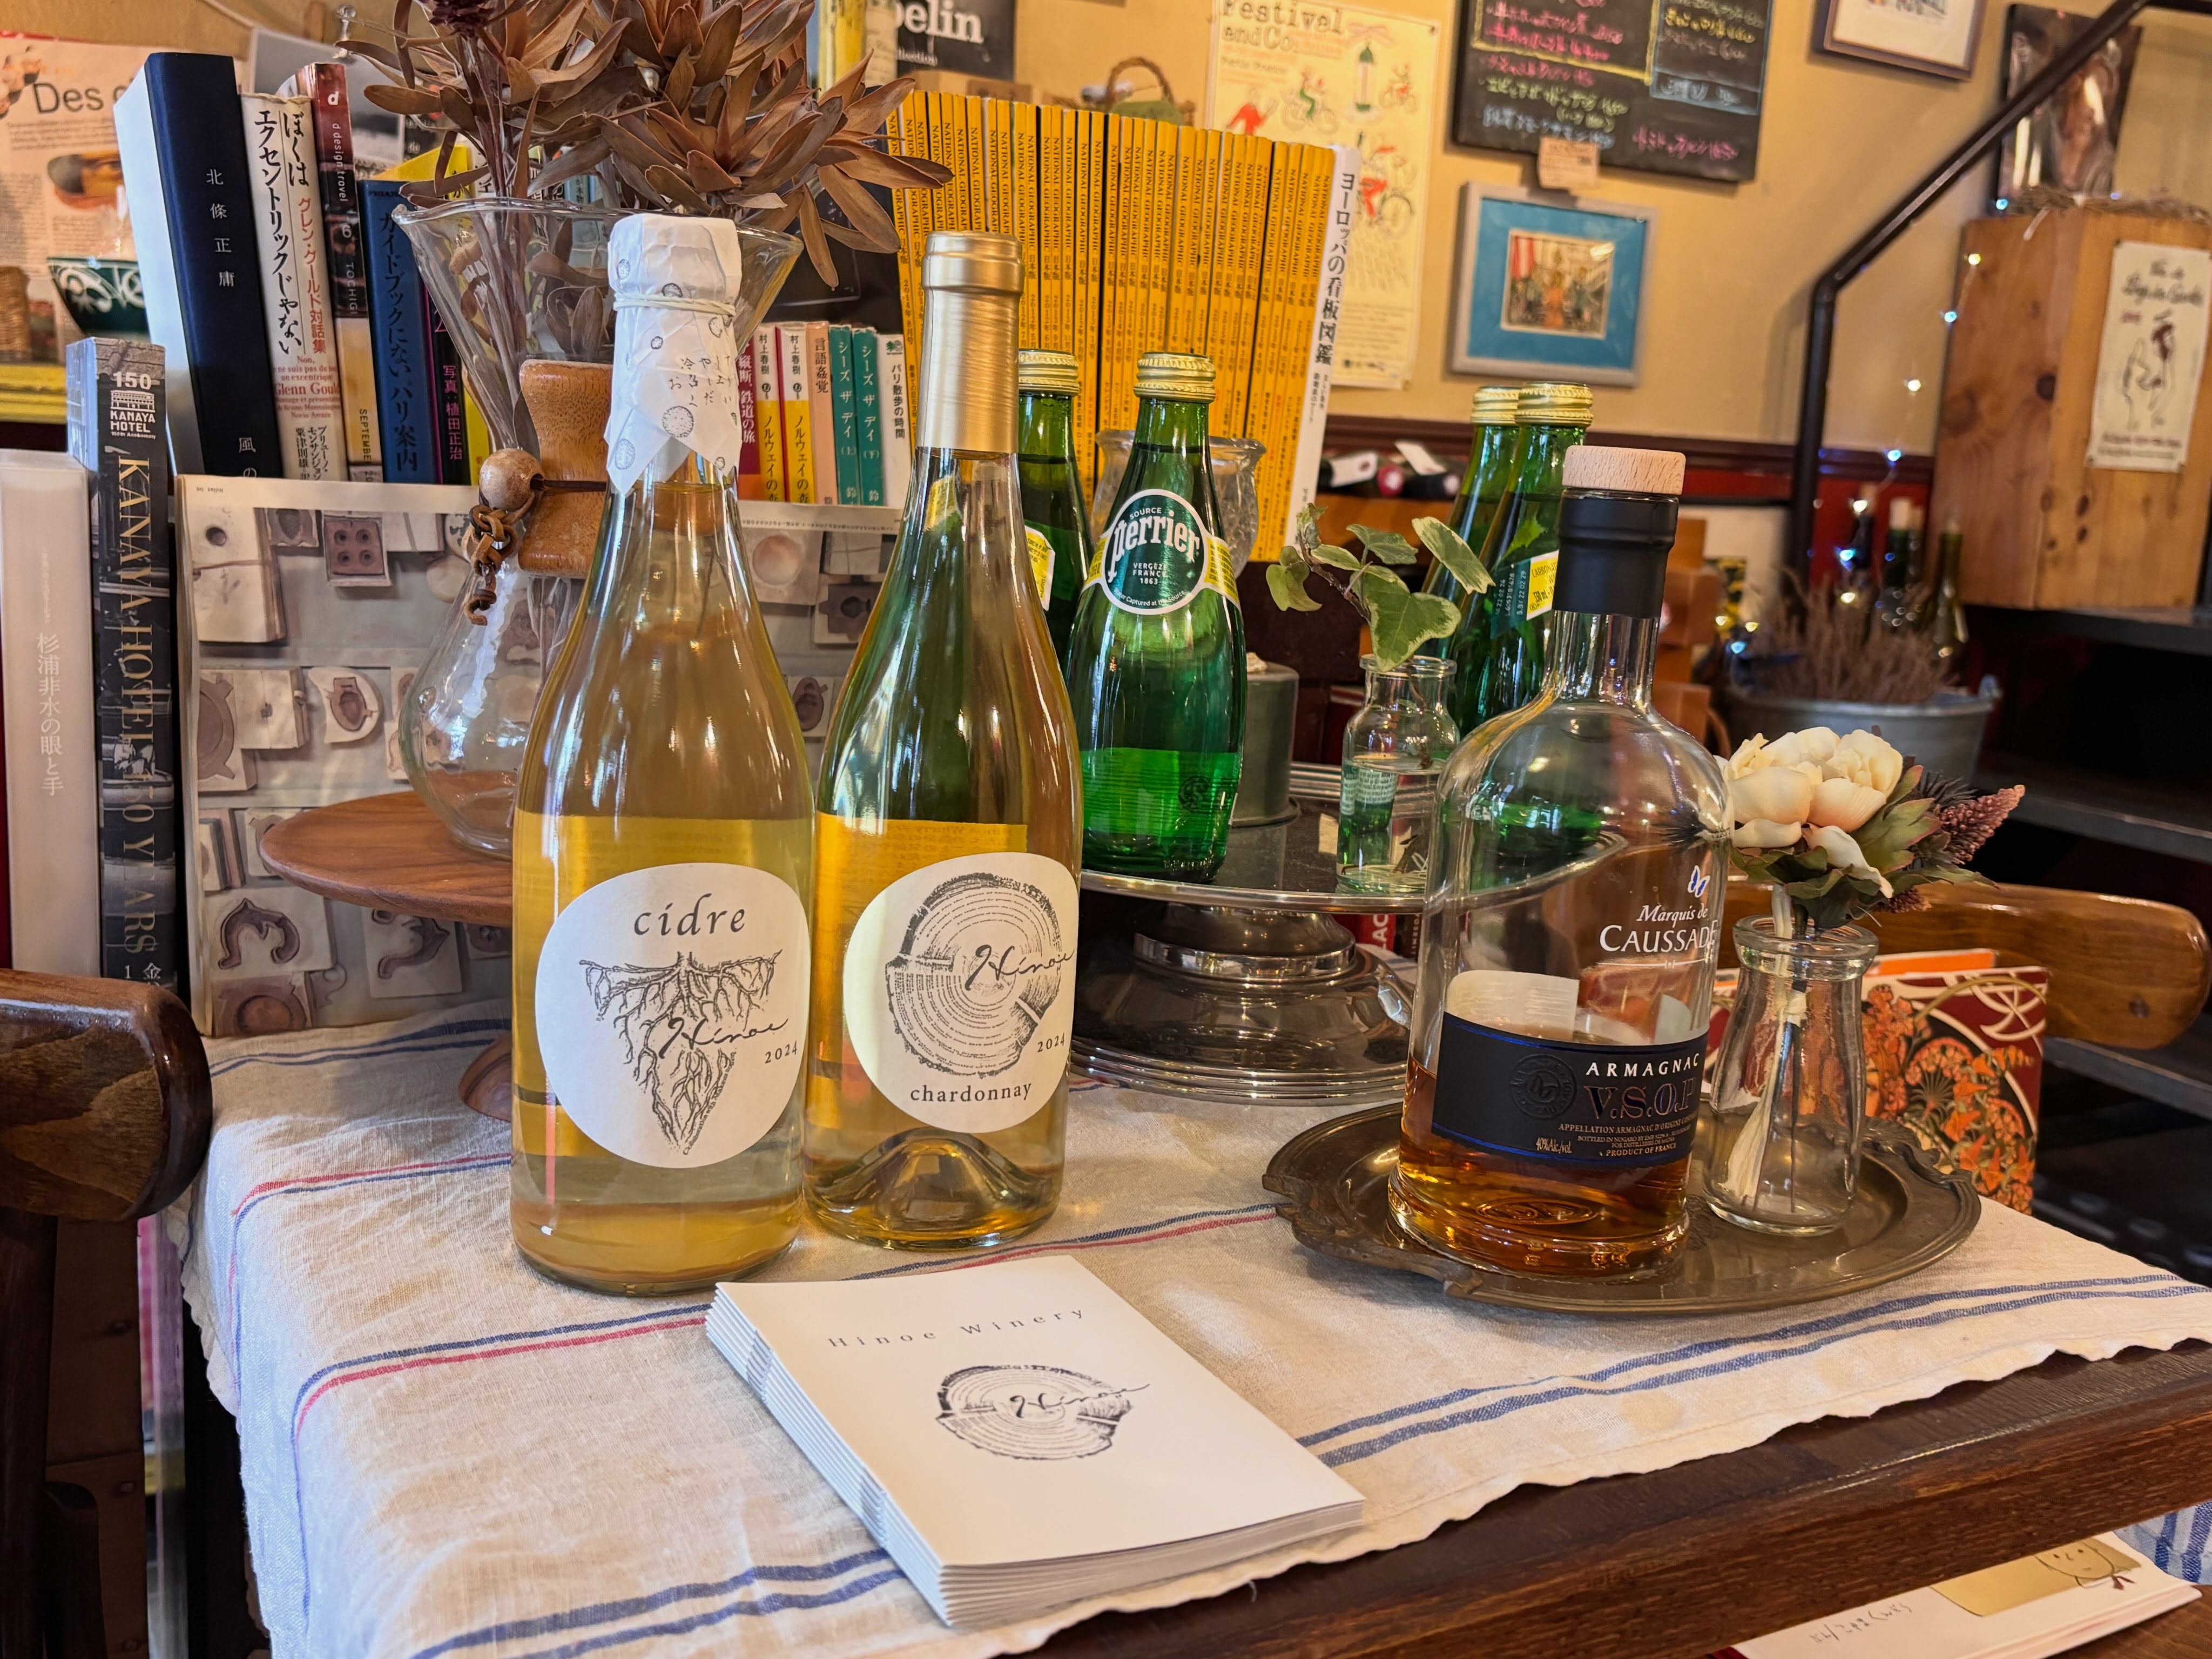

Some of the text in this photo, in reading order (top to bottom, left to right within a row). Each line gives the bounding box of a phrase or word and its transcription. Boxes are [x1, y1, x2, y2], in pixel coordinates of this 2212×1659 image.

[33, 83, 104, 113] Des
[328, 91, 339, 106] d
[283, 111, 309, 187] ぼくは
[333, 133, 342, 167] design
[957, 129, 966, 180] NATIONAL
[970, 127, 979, 178] NATIONAL
[989, 130, 997, 179] NATIONAL
[337, 171, 348, 203] travel
[1121, 147, 1132, 256] NATIONAL GEOGRAPHIC
[1207, 159, 1216, 204] NATIONAL
[1311, 176, 1321, 220] NATIONAL
[1319, 176, 1330, 219] NATIONAL
[254, 110, 302, 355] エクセントリックじゃない
[342, 224, 352, 239] 6
[1092, 191, 1101, 251] GEOGRAPHIC
[1131, 197, 1139, 255] GEOGRAPHIC
[1142, 200, 1150, 258] GEOGRAPHIC
[1154, 200, 1163, 259] GEOGRAPHIC
[1162, 155, 1175, 261] NATIONAL GEOGRAPHIC
[1177, 156, 1190, 264] NATIONAL GEOGRAPHIC
[1190, 159, 1203, 266] NATIONAL GEOGRAPHIC
[1217, 159, 1231, 266] NATIONAL GEOGRAPHIC
[1228, 162, 1242, 268] NATIONAL GEOGRAPHIC
[1239, 164, 1253, 269] NATIONAL GEOGRAPHIC
[1249, 165, 1263, 269] NATIONAL GEOGRAPHIC
[1266, 168, 1282, 272] NATIONAL GEOGRAPHIC
[1293, 173, 1309, 275] NATIONAL GEOGRAPHIC
[1281, 216, 1291, 272] GEOGRAPHIC
[1314, 173, 1355, 366] ヨーロッパの看板図鑑
[298, 198, 327, 354] グレン・グールド対話集
[346, 262, 358, 315] TOCHIGI
[759, 334, 770, 375] 村上春樹
[790, 335, 801, 375] 村上春樹
[112, 371, 152, 390] 150
[274, 382, 307, 396] Glenn
[891, 364, 906, 439] パリ散歩の時間
[110, 410, 156, 423] KANAYA
[110, 421, 151, 433] HOTEL
[359, 408, 372, 461] SEPTEMBE
[119, 455, 152, 611] KANAYA
[1129, 507, 1162, 520] SOURCE
[1108, 509, 1200, 583] perrier
[120, 623, 154, 742] HOTEL
[36, 632, 64, 797] 杉浦非水の眼と手
[633, 893, 746, 936] cidre
[1636, 903, 1709, 928] Marquis de
[764, 1040, 798, 1064] 2024
[1037, 1033, 1065, 1053] 2024
[1585, 1053, 1700, 1077] ARMAGNAC
[910, 1082, 1032, 1103] chardonnay
[1558, 1124, 1615, 1134] APPELLATION
[1616, 1123, 1654, 1134] ARMAGNAC
[1606, 1148, 1644, 1157] PRODUCT
[1655, 1143, 1677, 1153] FRANCE
[827, 1309, 1084, 1348] Hinoe Winery
